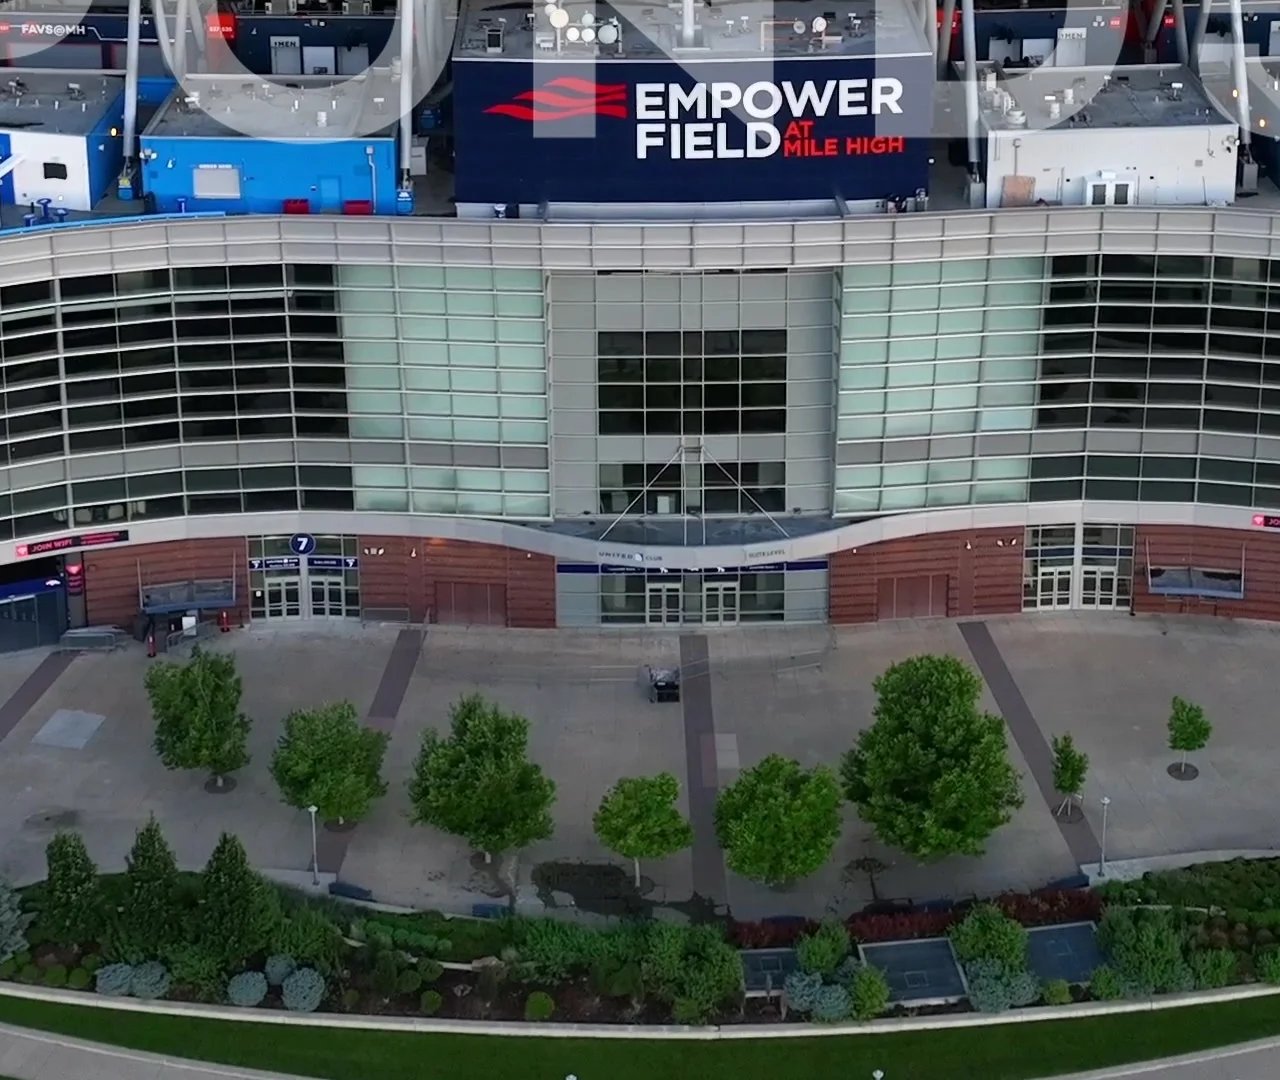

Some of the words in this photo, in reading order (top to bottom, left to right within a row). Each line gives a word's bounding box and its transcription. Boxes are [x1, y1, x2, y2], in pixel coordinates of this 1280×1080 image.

[21, 23, 85, 37] FAVS@MH
[635, 77, 903, 120] EMPOWER
[784, 120, 814, 139] AT
[636, 122, 780, 159] FIELD
[784, 138, 838, 158] MILE
[846, 135, 903, 155] HIGH
[32, 541, 53, 552] JOIN
[54, 539, 73, 549] WIFI
[298, 538, 308, 551] 7
[599, 551, 634, 560] UNITED
